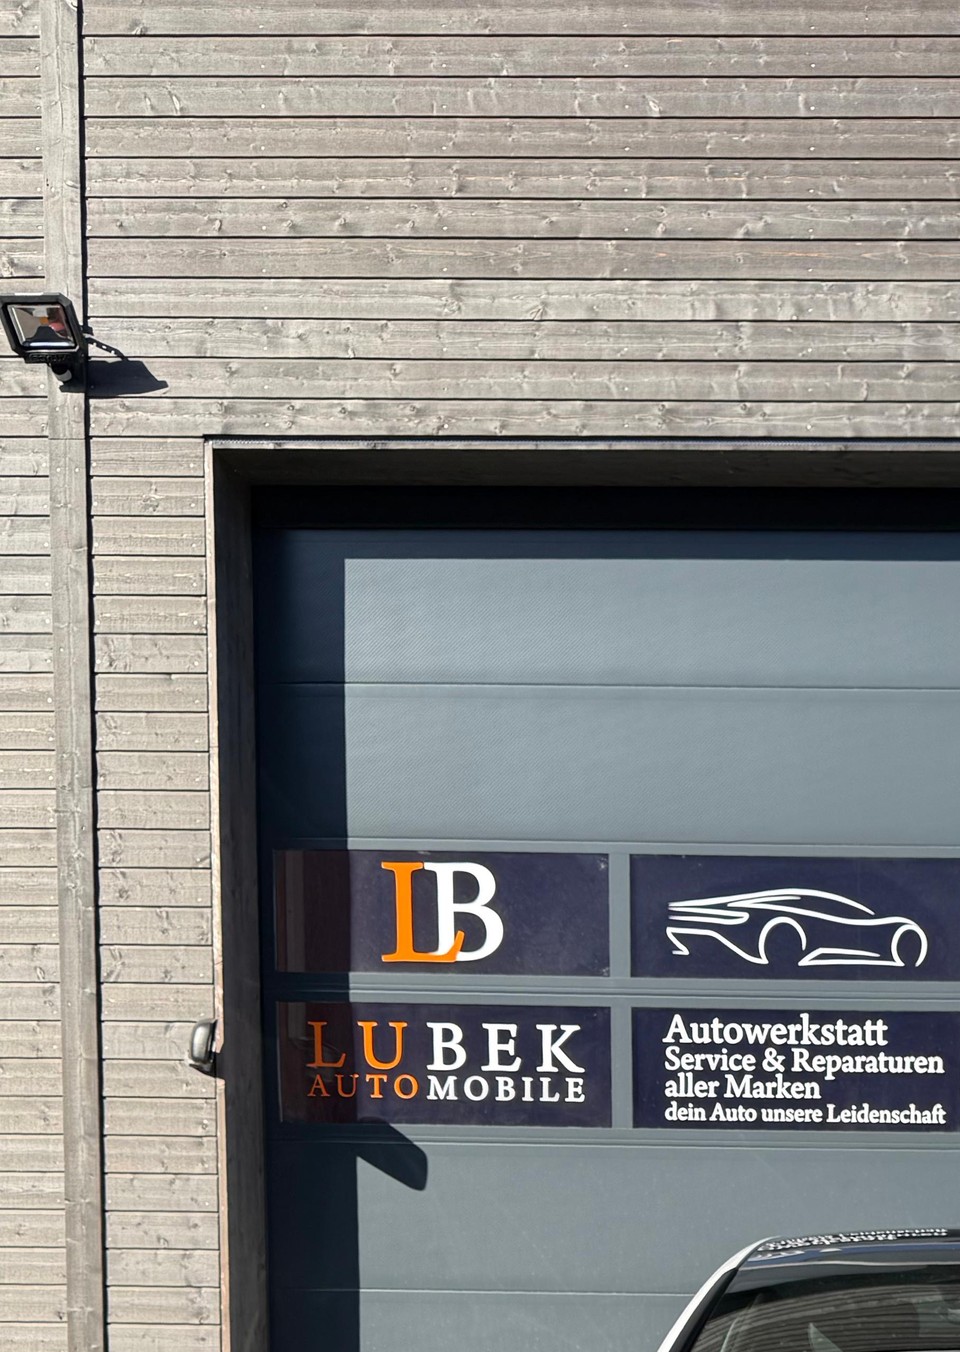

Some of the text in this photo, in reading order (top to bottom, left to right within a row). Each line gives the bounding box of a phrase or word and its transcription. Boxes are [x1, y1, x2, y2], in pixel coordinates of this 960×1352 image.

[662, 1013, 888, 1046] Autowerkstatt
[307, 1020, 586, 1074] LUBEK
[664, 1045, 945, 1080] Service & Reparaturen
[307, 1074, 586, 1103] AUTOMOBILE
[664, 1072, 821, 1099] aller Marken
[664, 1101, 946, 1125] dein Auto unsere Leidenschaft
